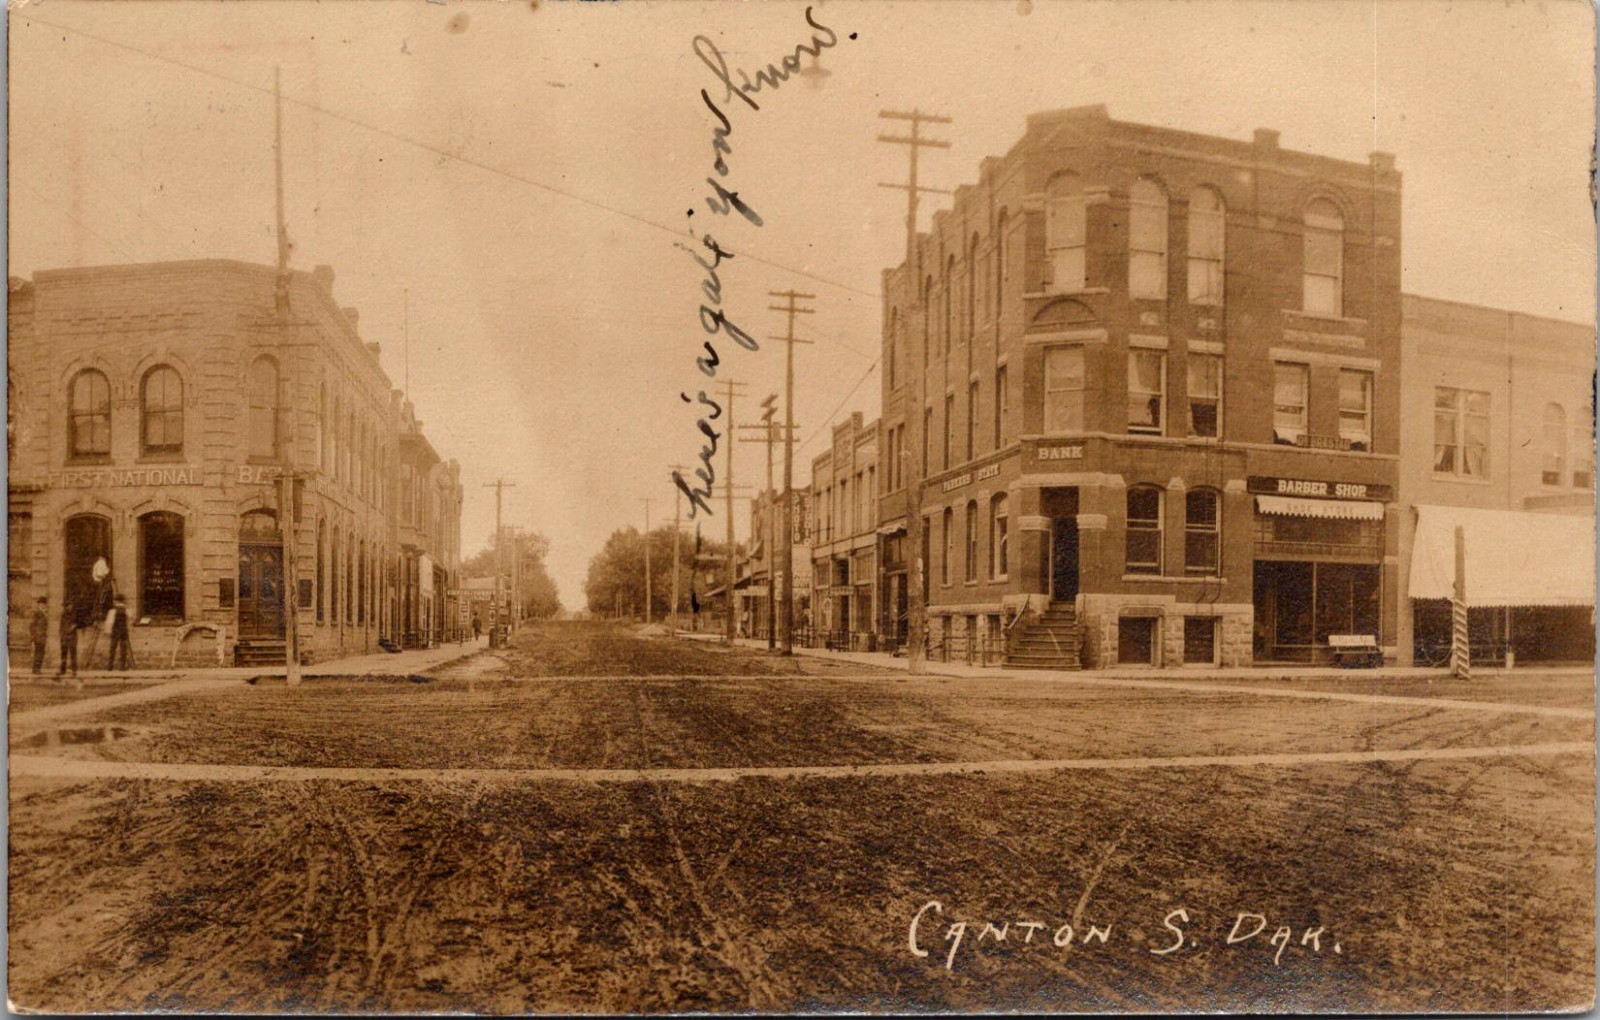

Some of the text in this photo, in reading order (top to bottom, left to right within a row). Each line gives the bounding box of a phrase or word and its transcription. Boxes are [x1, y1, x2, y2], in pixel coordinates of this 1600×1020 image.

[696, 341, 720, 377] a
[672, 391, 722, 519] here's
[1038, 446, 1083, 460] BANK
[49, 471, 105, 489] FIRST
[110, 468, 203, 487] NATIONAL
[978, 463, 999, 481] STATE
[1278, 480, 1328, 495] BARBER
[793, 494, 801, 542] PHOTO
